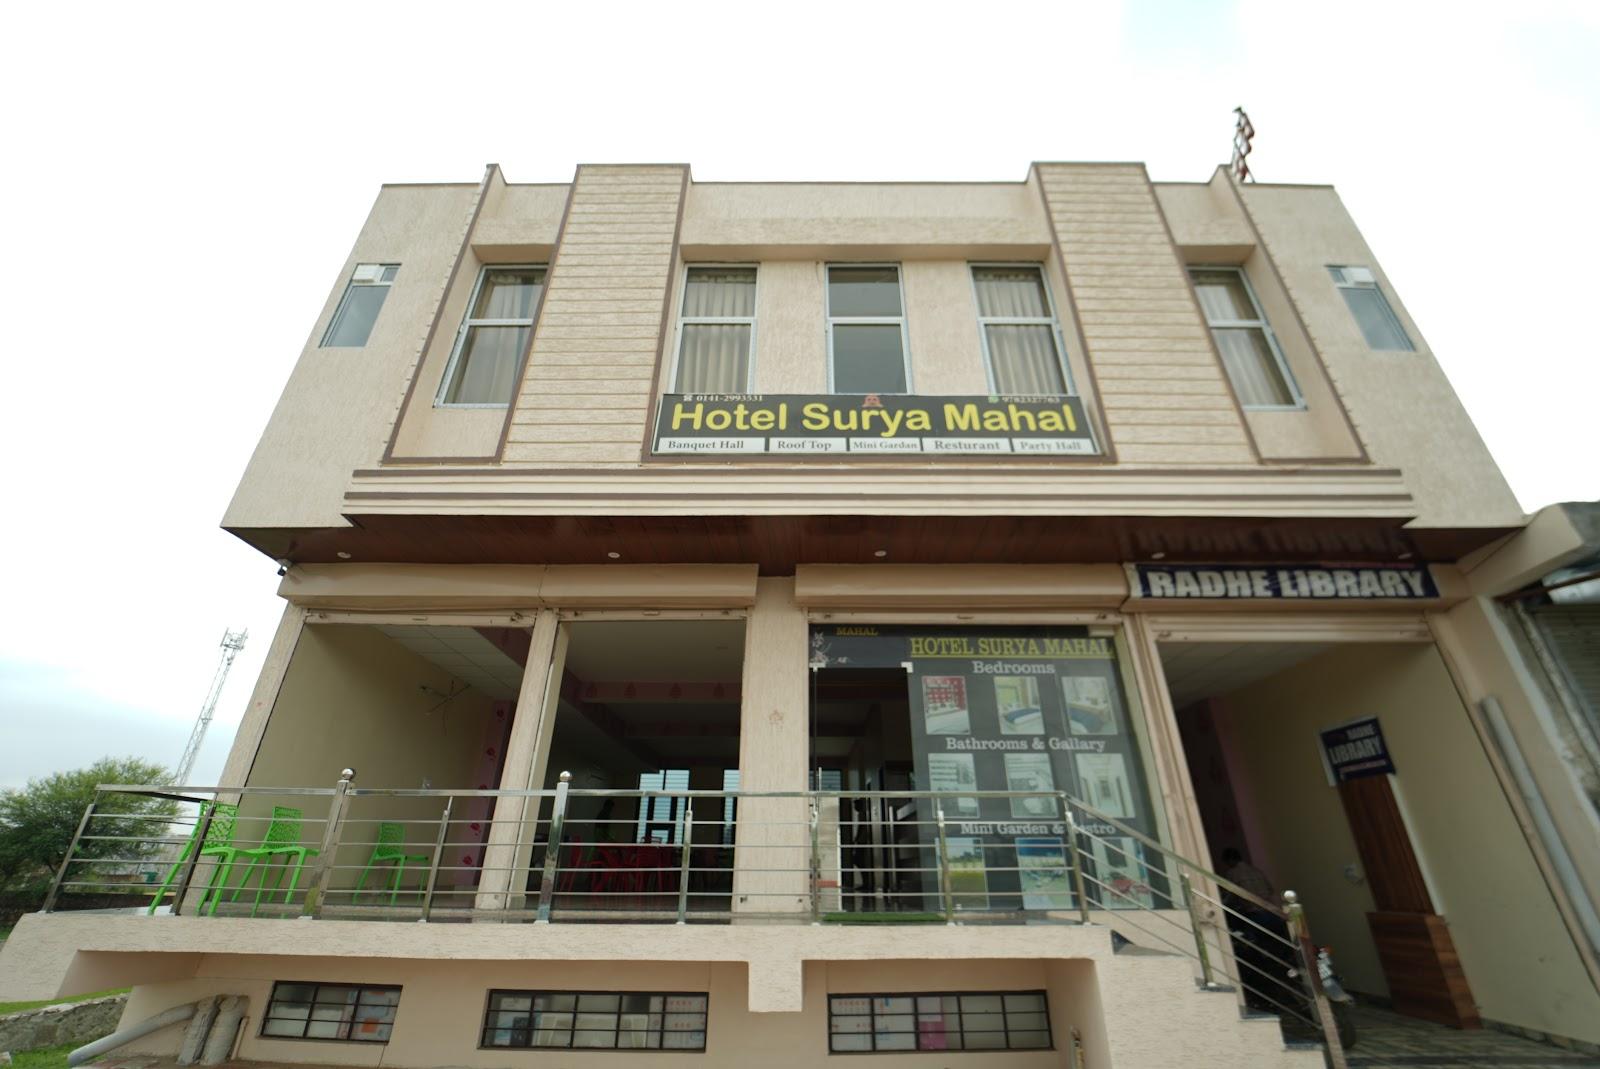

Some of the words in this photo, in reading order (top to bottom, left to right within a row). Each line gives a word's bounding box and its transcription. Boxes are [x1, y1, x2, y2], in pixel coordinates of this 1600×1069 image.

[671, 402, 787, 431] Hotel
[801, 403, 932, 438] Surya
[943, 403, 1078, 432] Mahal
[668, 440, 715, 451] Banquet
[720, 440, 744, 449] Hall
[777, 440, 806, 449] Roof
[810, 440, 832, 451] Top
[853, 440, 876, 449] Mini
[934, 440, 1000, 450] Resturant
[1020, 441, 1050, 452] Party
[1056, 441, 1081, 450] Hall
[1147, 570, 1273, 598] RADHE
[1277, 570, 1426, 598] LIBRARY
[836, 627, 879, 636] MAHAL
[910, 637, 975, 654] HOTEL
[978, 638, 1040, 655] SURYA
[972, 661, 1056, 674] Bedrooms
[946, 737, 1028, 750] Bathrooms
[1031, 738, 1045, 750] &
[1048, 738, 1106, 752] Gallary
[1328, 735, 1383, 765] LIBRARY
[961, 823, 993, 834] Mini
[997, 823, 1049, 834] Garden
